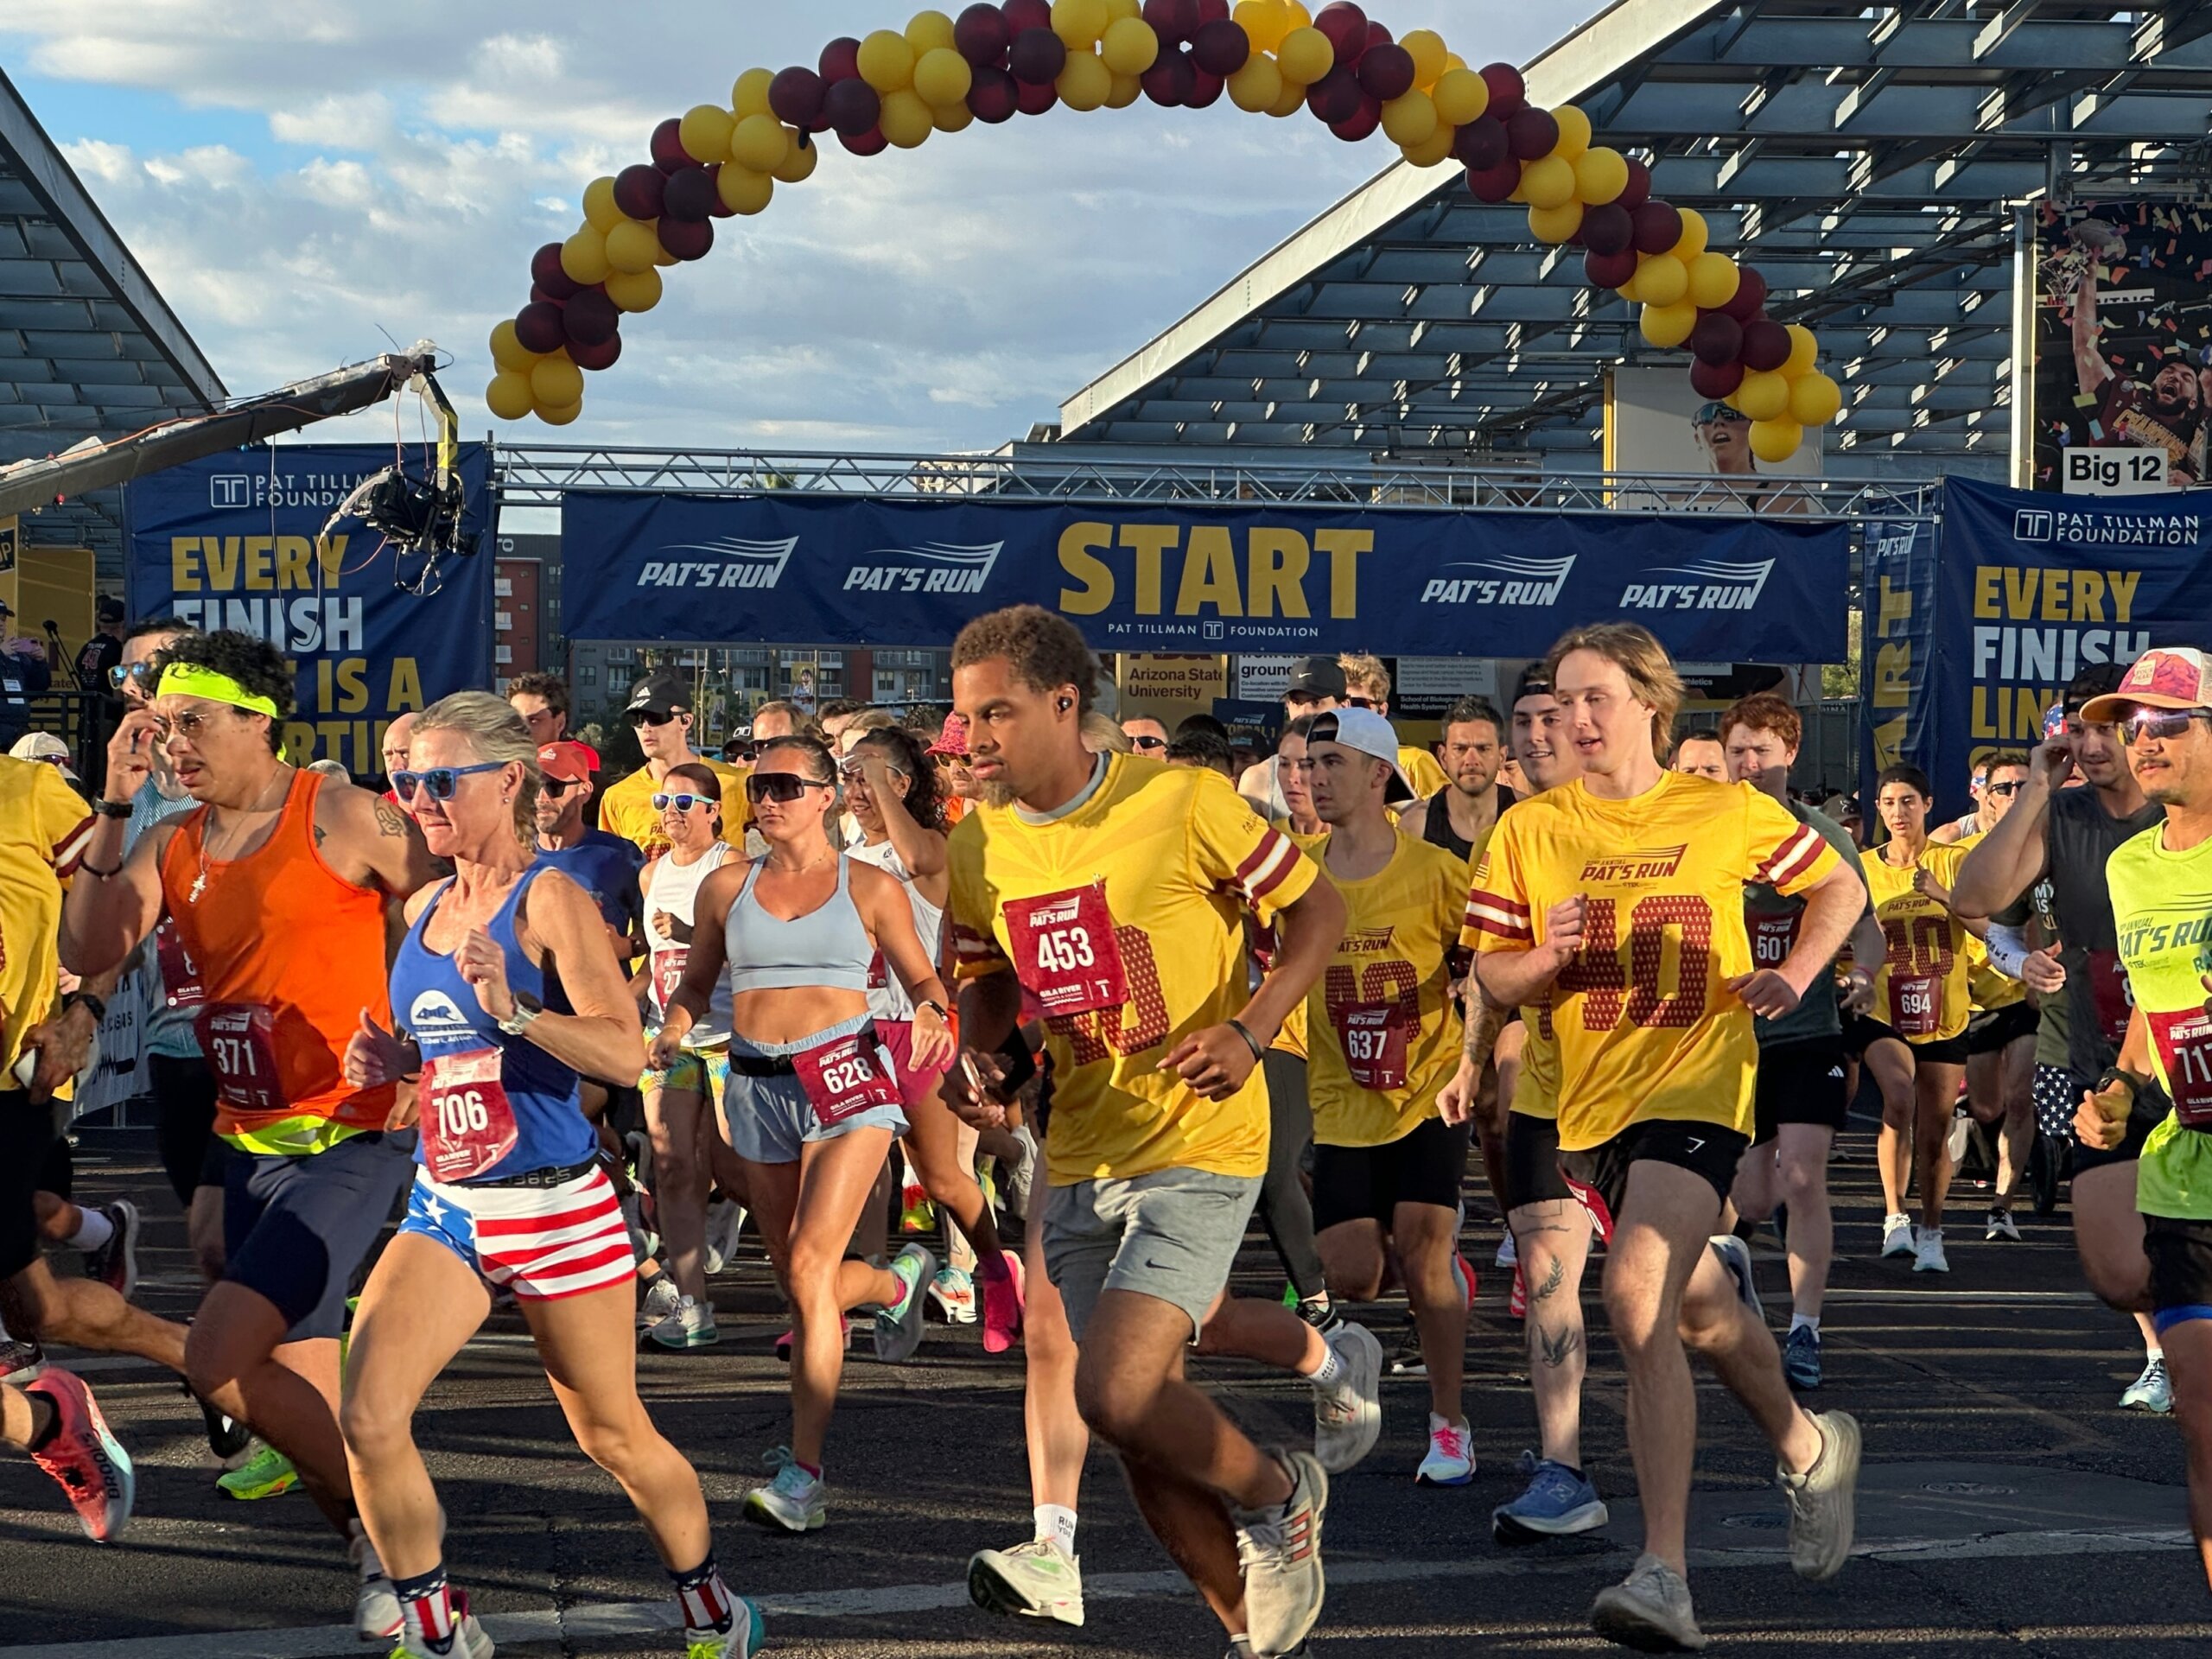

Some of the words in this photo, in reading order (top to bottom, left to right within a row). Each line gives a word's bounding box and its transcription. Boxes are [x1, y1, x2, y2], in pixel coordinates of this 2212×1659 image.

[256, 475, 294, 489] PAT
[309, 474, 371, 489] TILLM
[2069, 455, 2120, 486] Big
[2128, 456, 2160, 480] 12
[256, 493, 351, 506] FOUNDA
[2056, 527, 2198, 544] FOUNDATION
[2057, 512, 2093, 525] PAT
[2103, 516, 2198, 528] TILLMAN
[171, 535, 349, 592] EVERY
[638, 563, 718, 588] PAT'S
[719, 553, 788, 588] RUN
[843, 567, 926, 592] PAT'S
[925, 558, 995, 594] RUN
[1058, 522, 1374, 620] START
[1421, 579, 1500, 604] PAT'S
[1498, 570, 1567, 606] RUN
[1619, 585, 1699, 608] PAT'S
[1697, 575, 1764, 610] RUN
[1974, 566, 2141, 623] EVERY
[1108, 624, 1131, 634] PAT
[1137, 624, 1198, 635] TILLMAN
[1230, 626, 1319, 638] FOUNDATION
[1974, 626, 2150, 682] FINISH
[317, 658, 369, 714] IS
[386, 657, 424, 712] A
[1129, 667, 1185, 681] Arizona
[1128, 684, 1201, 700] University
[1971, 686, 2062, 741] LIN
[1580, 864, 1636, 881] PAT'S
[1635, 854, 1683, 879] RUN
[1029, 912, 1056, 928] PAT'S
[1056, 904, 1080, 923] RUN
[1038, 927, 1095, 973] 453
[1363, 934, 1392, 951] RUN
[1757, 935, 1791, 961] 501
[1881, 913, 1955, 976] 40
[1556, 895, 1713, 1032] 40
[664, 970, 685, 995] 27
[1058, 984, 1082, 995] RIVER
[1902, 994, 1932, 1014] 694
[213, 1038, 257, 1076] 371
[1347, 1029, 1388, 1061] 637
[823, 1057, 874, 1094] 628
[432, 1090, 489, 1140] 706
